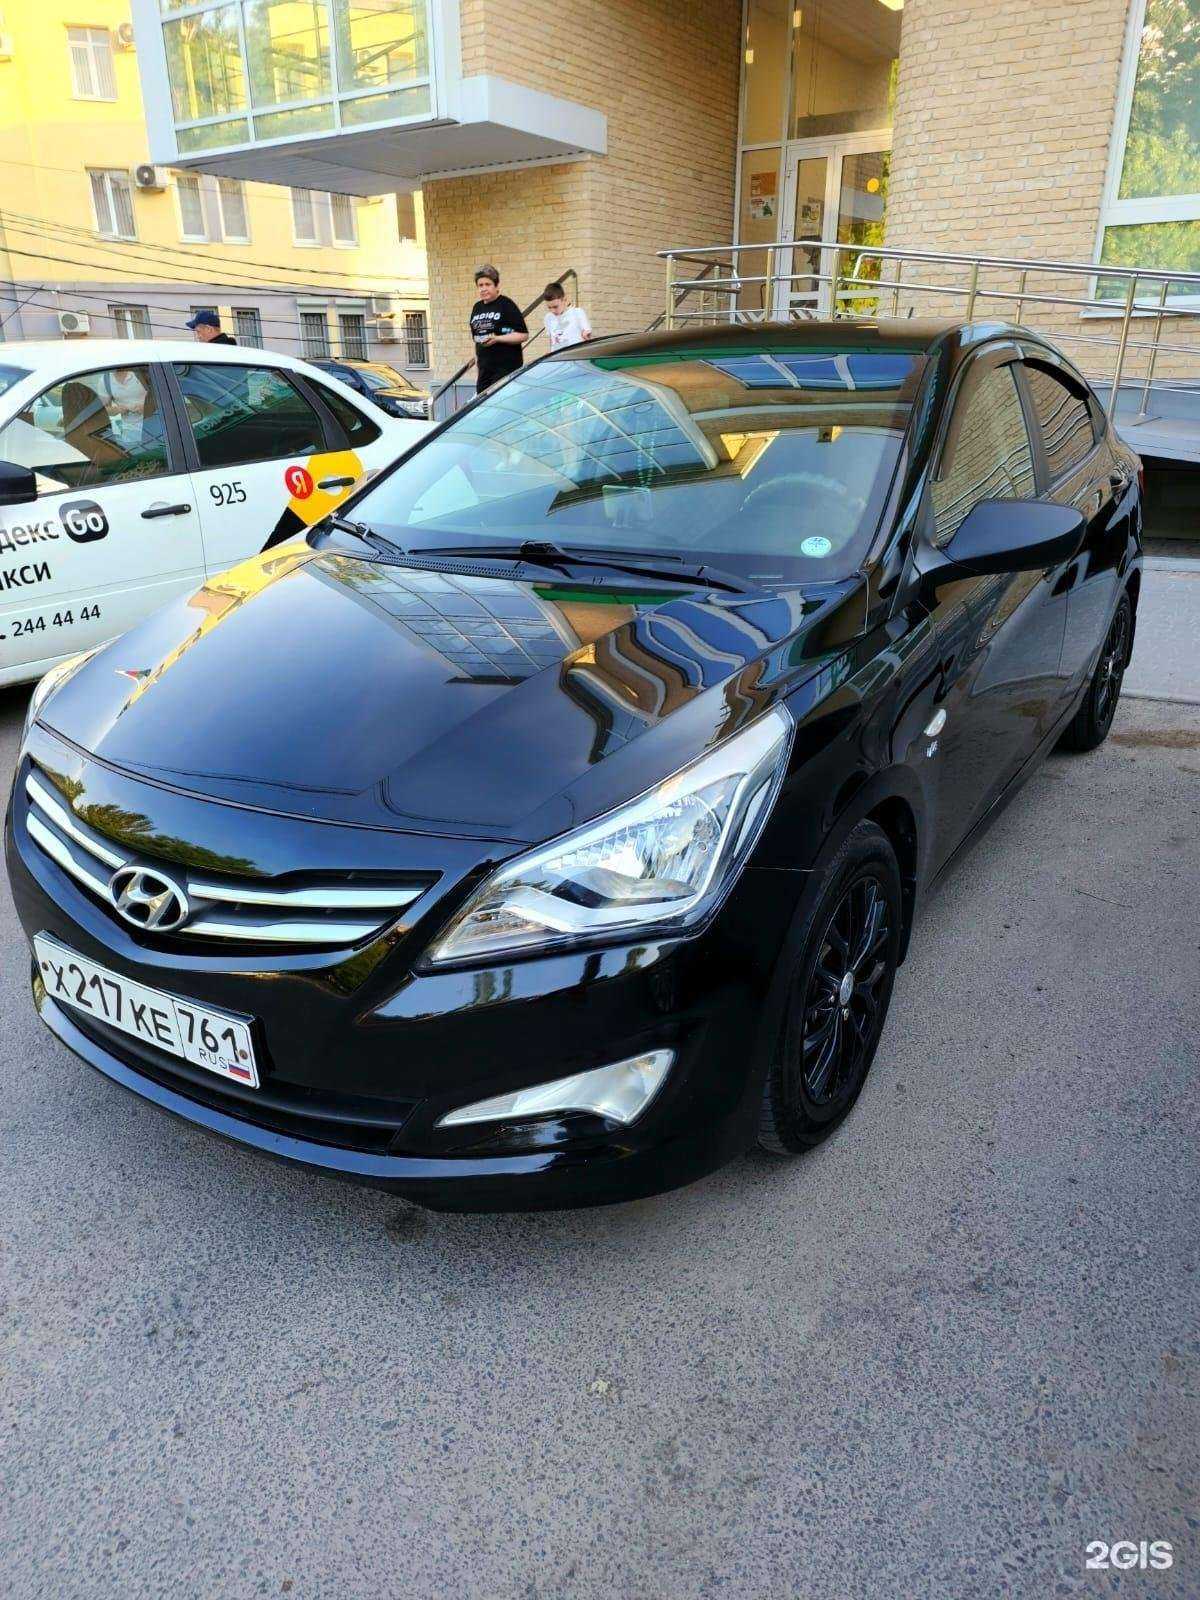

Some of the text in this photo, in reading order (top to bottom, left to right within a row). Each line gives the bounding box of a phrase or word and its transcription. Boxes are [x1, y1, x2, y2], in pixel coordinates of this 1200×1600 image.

[209, 481, 247, 506] 925
[65, 508, 104, 536] Go
[12, 604, 101, 637] 244 44 44
[178, 1008, 240, 1063] 761
[199, 1048, 228, 1070] RUS
